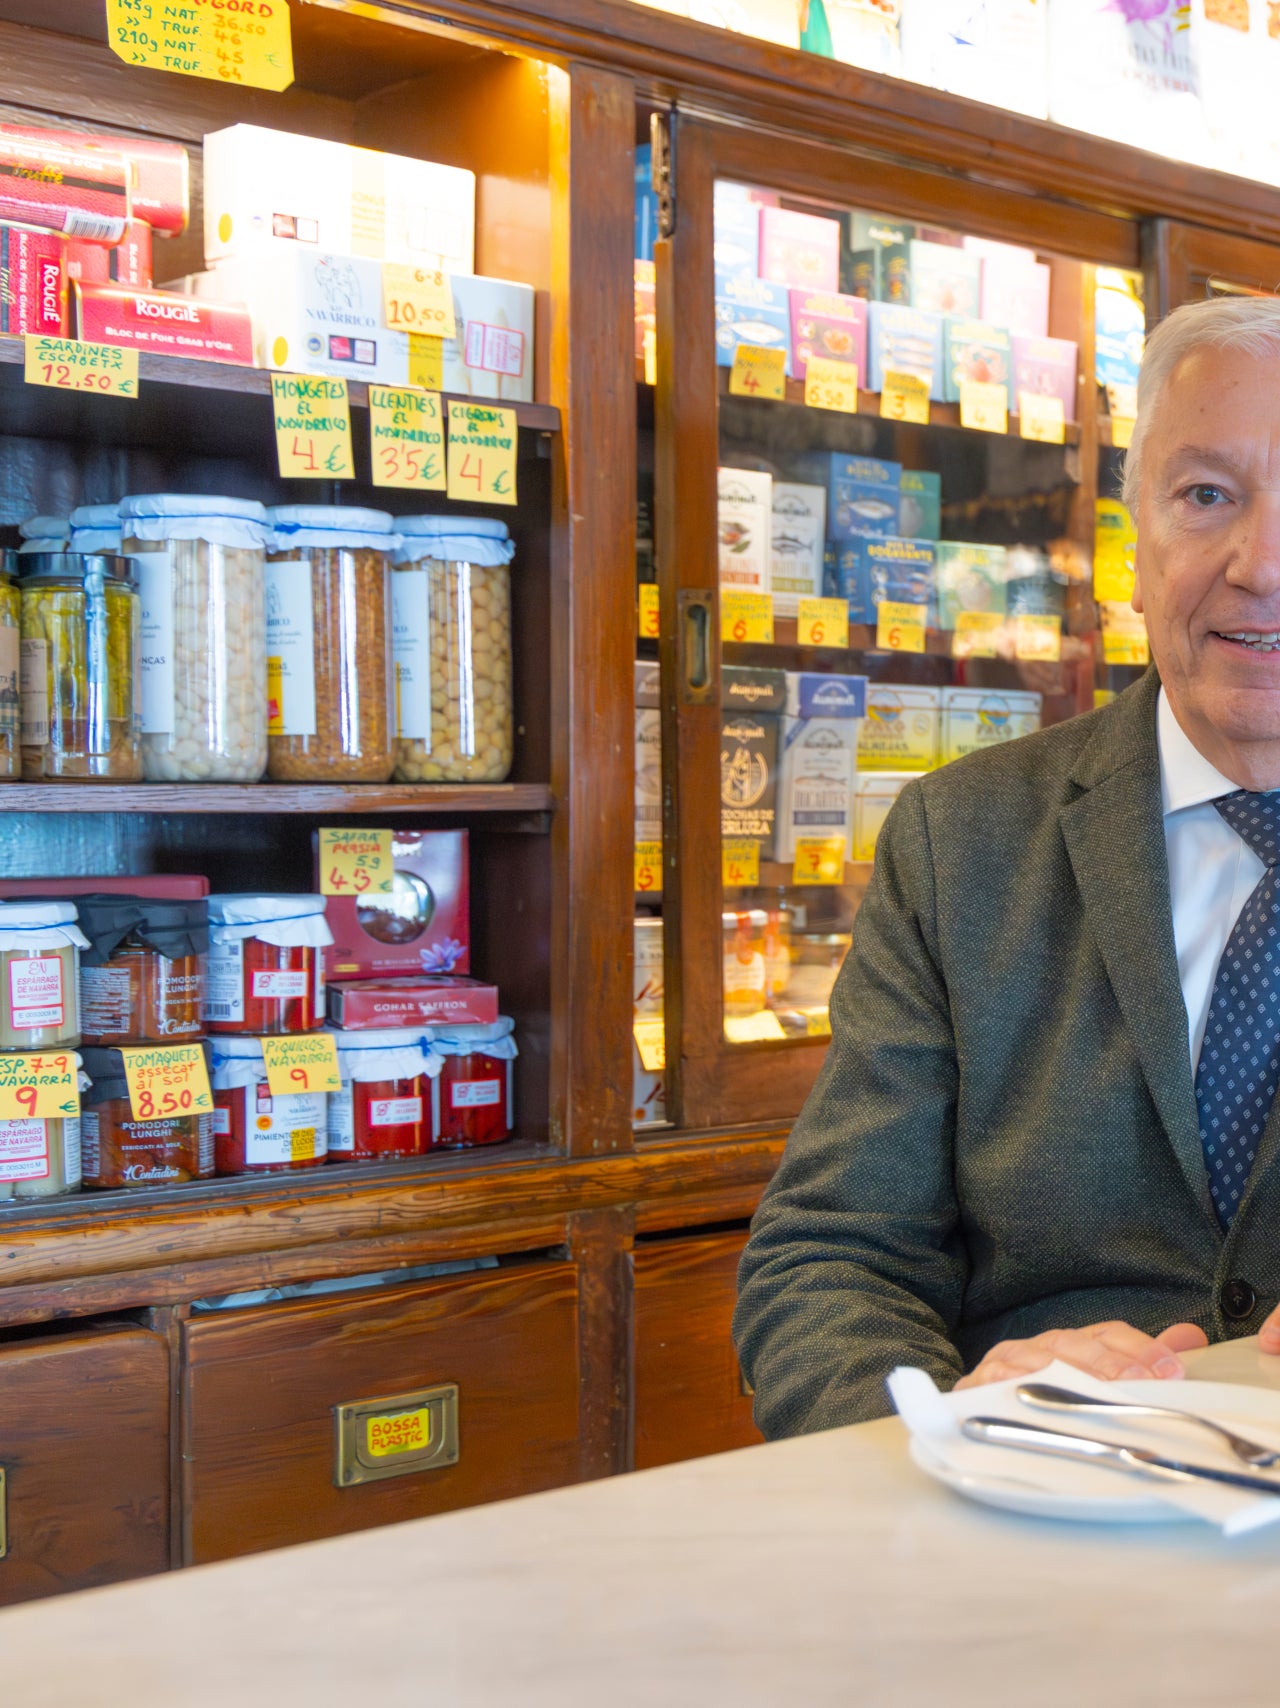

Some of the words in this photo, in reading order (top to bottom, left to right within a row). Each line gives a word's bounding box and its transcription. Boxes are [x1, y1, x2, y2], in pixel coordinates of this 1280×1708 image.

[117, 27, 158, 52] 210g
[216, 49, 244, 64] 45
[213, 29, 242, 45] 46
[218, 66, 243, 81] 64
[38, 351, 124, 370] ESCABETX
[41, 363, 112, 391] 12,50
[118, 379, 135, 393] €
[274, 378, 345, 400] MONGETES
[743, 370, 760, 394] 4
[371, 389, 437, 418] LLENTIES
[291, 436, 320, 471] 4
[325, 444, 346, 473] €
[458, 453, 484, 493] 4
[491, 469, 511, 495] €
[732, 620, 748, 642] 6
[809, 620, 825, 644] 6
[887, 627, 901, 648] 6
[728, 863, 745, 885] 4
[30, 1055, 68, 1074] 7-9
[268, 1051, 334, 1068] NAVARRA
[0, 1073, 72, 1087] NAVARRA
[136, 1077, 152, 1091] al
[162, 1072, 190, 1087] sol
[137, 1063, 197, 1079] assecat
[290, 1068, 309, 1090] 9
[15, 1085, 38, 1117] 9
[58, 1100, 79, 1113] €
[121, 1120, 181, 1131] POMODORI
[130, 1128, 173, 1139] LUNGHI
[371, 1416, 420, 1438] BOSSA
